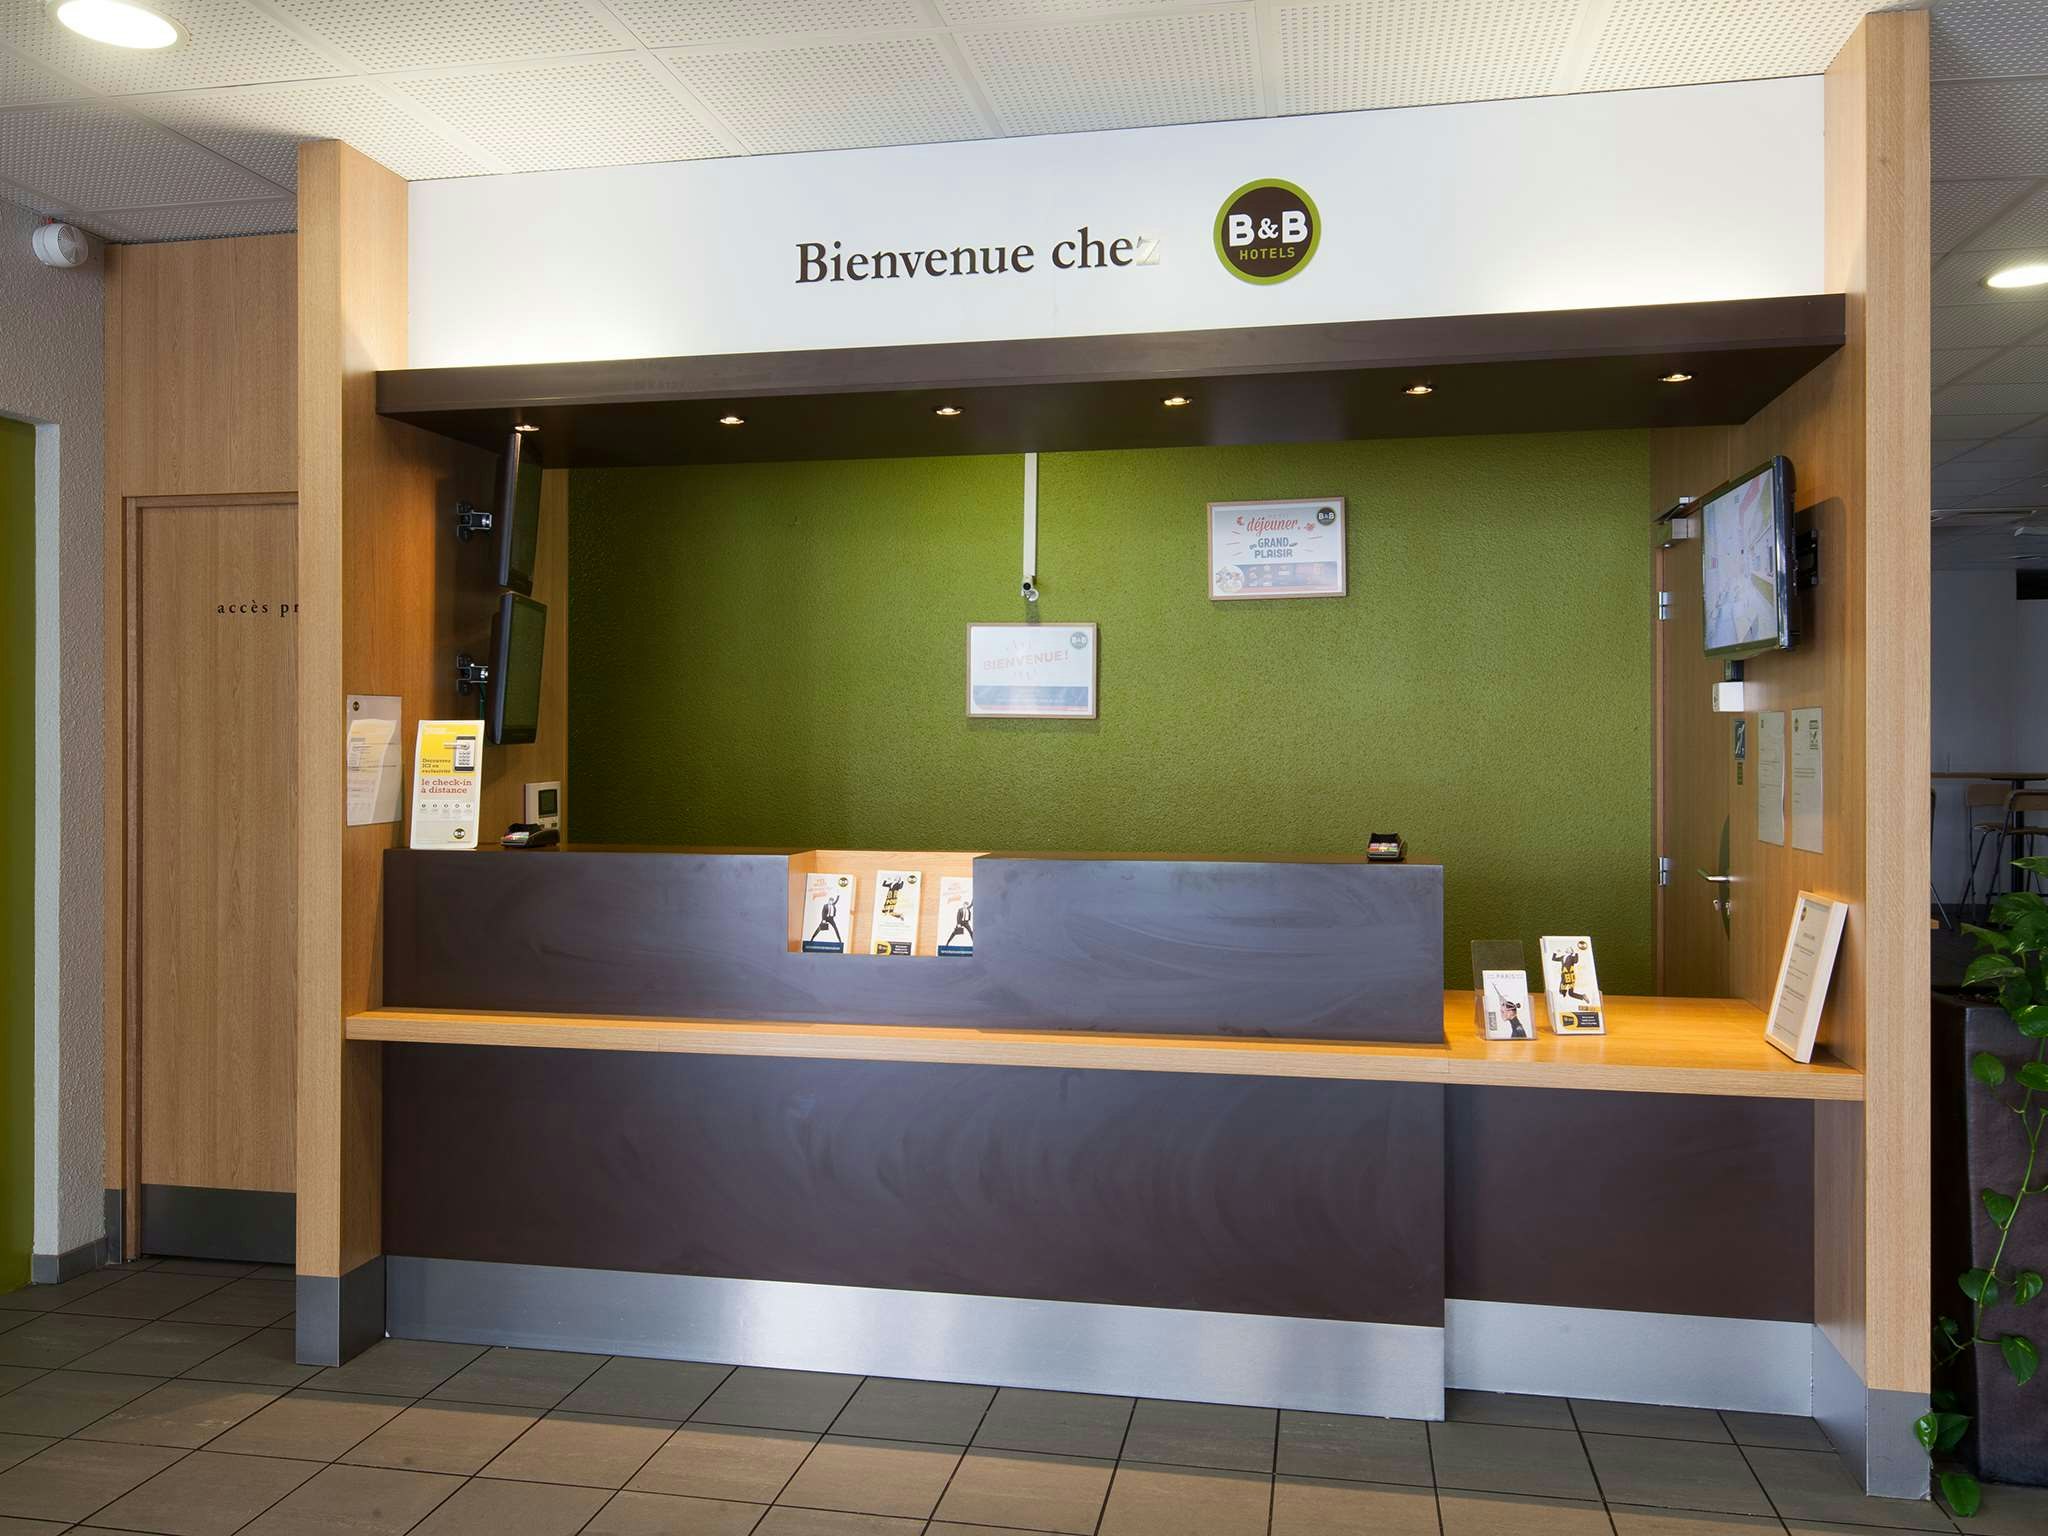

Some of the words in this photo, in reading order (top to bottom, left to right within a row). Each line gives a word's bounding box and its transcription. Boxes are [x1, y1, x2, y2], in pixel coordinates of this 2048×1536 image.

[1228, 210, 1308, 248] B&B
[1239, 246, 1295, 261] HOTELS
[795, 240, 1035, 284] Bienvenue
[1257, 537, 1289, 549] GRAND
[1254, 548, 1294, 559] PLAISIR
[217, 600, 268, 614] accès
[983, 649, 1069, 671] BIENVENUE!
[421, 778, 431, 786] le
[432, 778, 473, 786] check-in
[428, 786, 468, 794] distance
